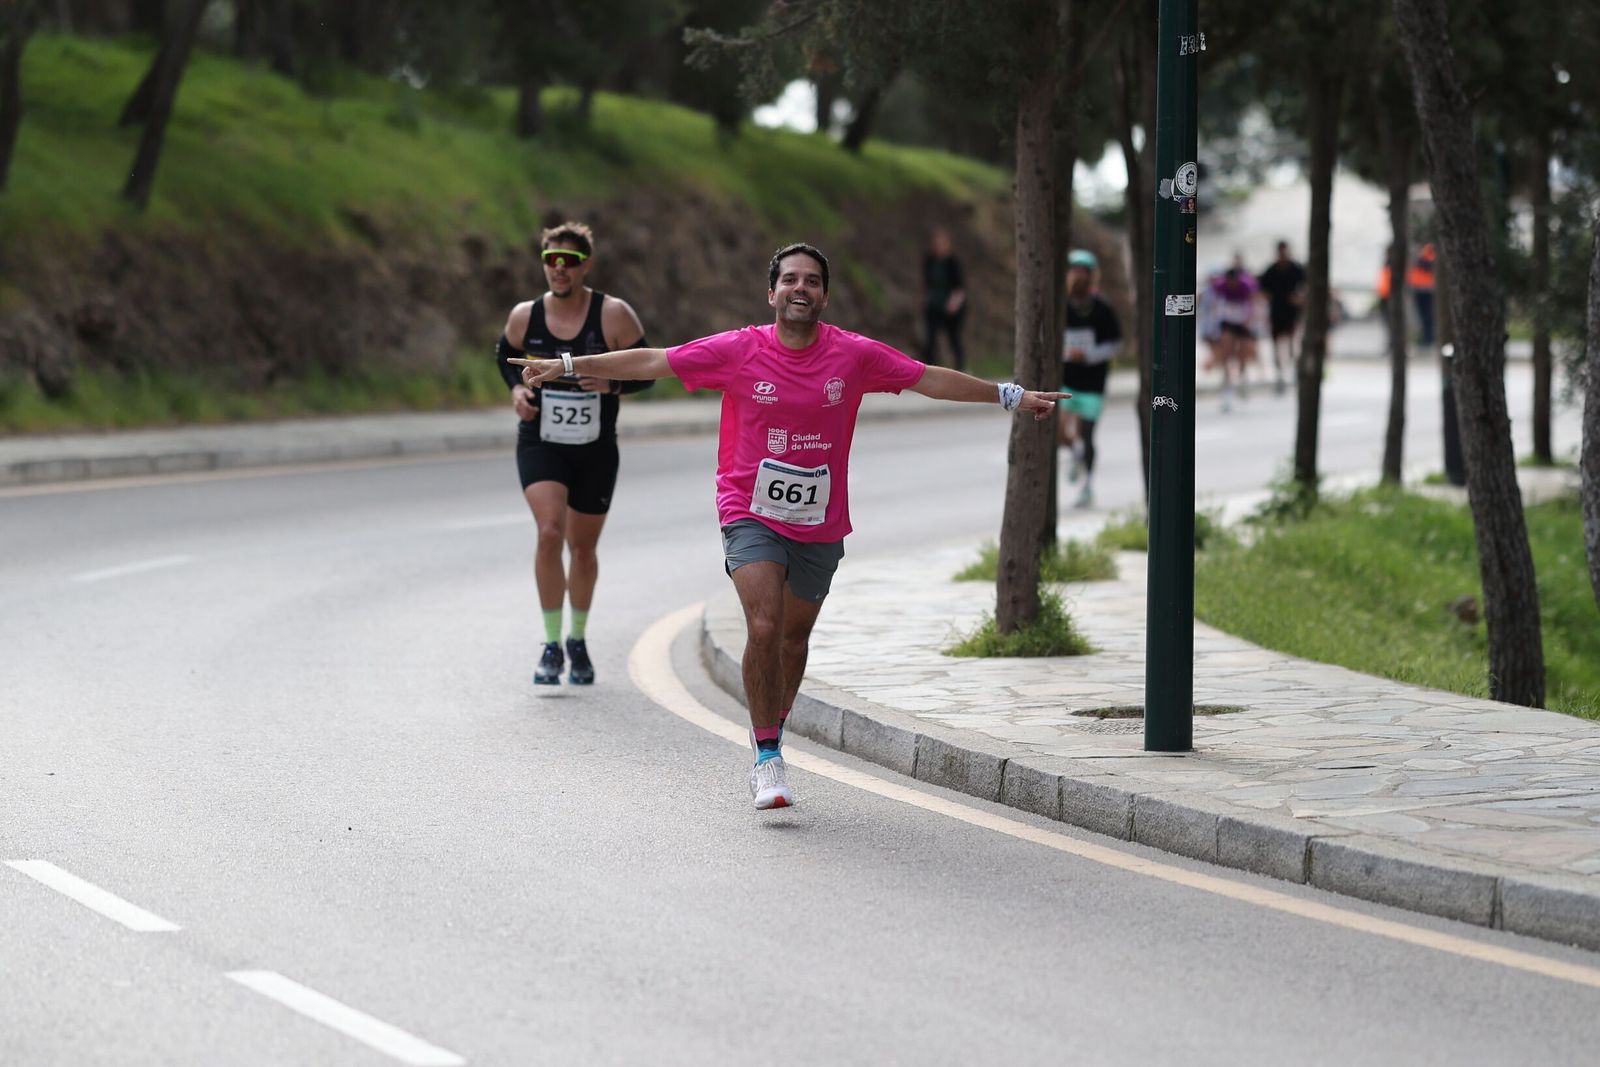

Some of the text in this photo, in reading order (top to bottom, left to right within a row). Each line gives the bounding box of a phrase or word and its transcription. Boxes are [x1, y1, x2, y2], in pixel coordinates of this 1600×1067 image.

[552, 406, 591, 425] 525
[791, 433, 821, 442] Ciudad
[791, 442, 832, 451] de Málaga
[767, 479, 818, 505] 661
